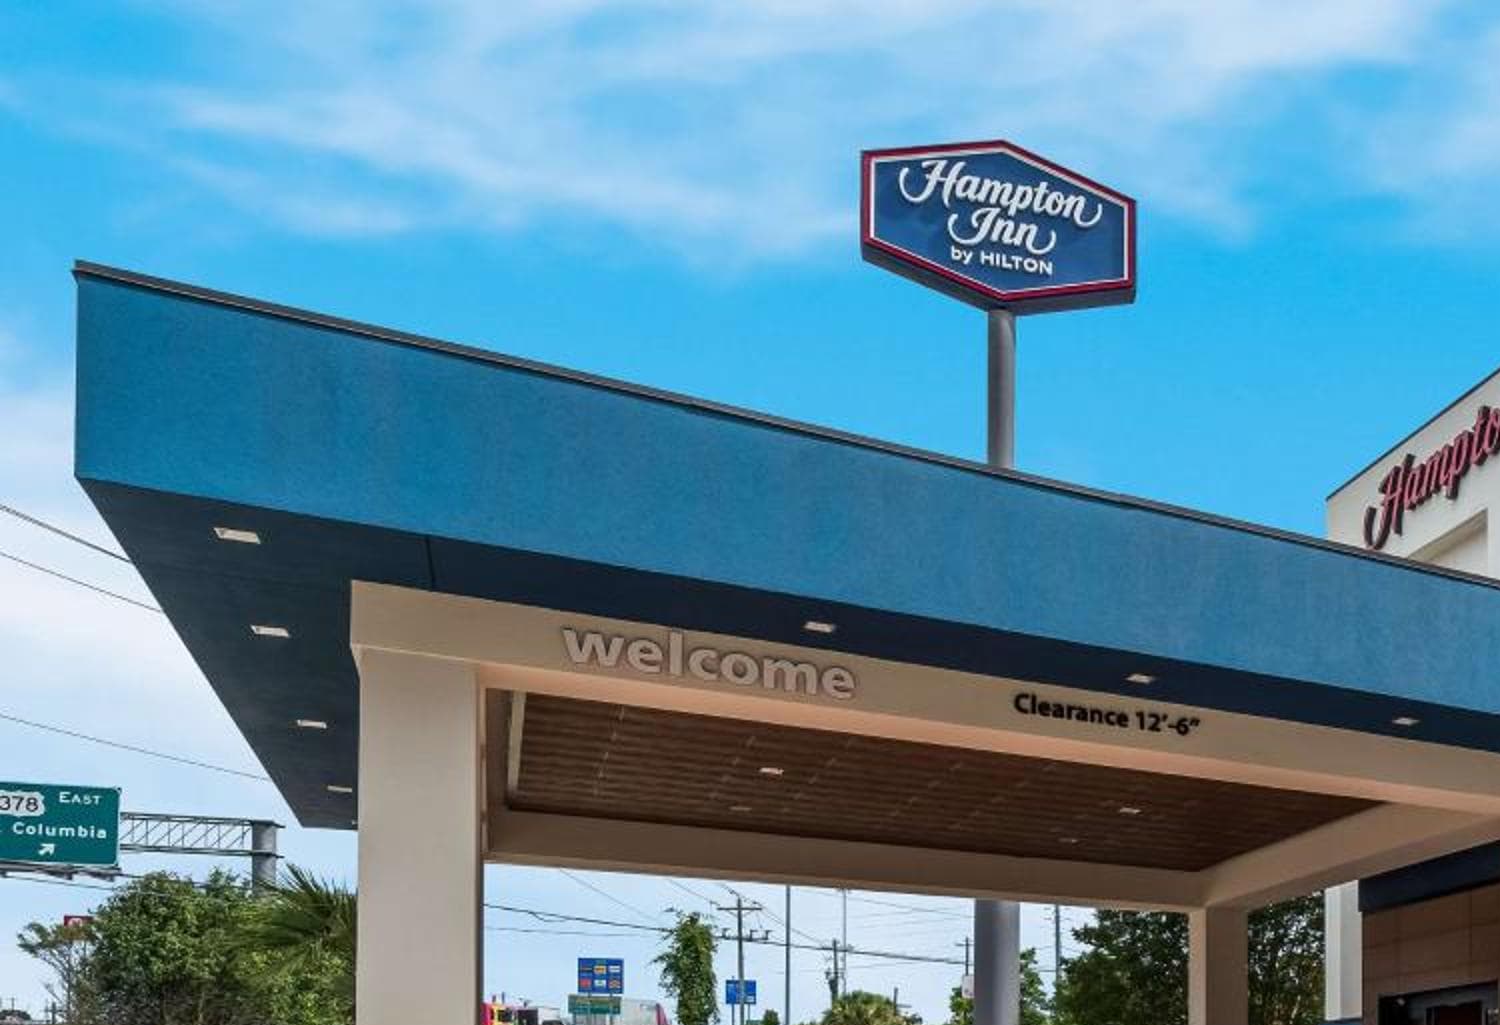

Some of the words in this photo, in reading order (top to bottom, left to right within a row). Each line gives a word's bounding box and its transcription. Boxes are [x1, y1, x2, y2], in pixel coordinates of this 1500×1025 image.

[899, 159, 1103, 228] Hampton
[947, 207, 1056, 254] Inn
[951, 245, 973, 265] by
[980, 250, 1053, 275] HILTON
[561, 626, 856, 700] welcome
[1013, 692, 1130, 729] Clearance
[0, 795, 39, 812] 378
[12, 821, 107, 839] Columbia
